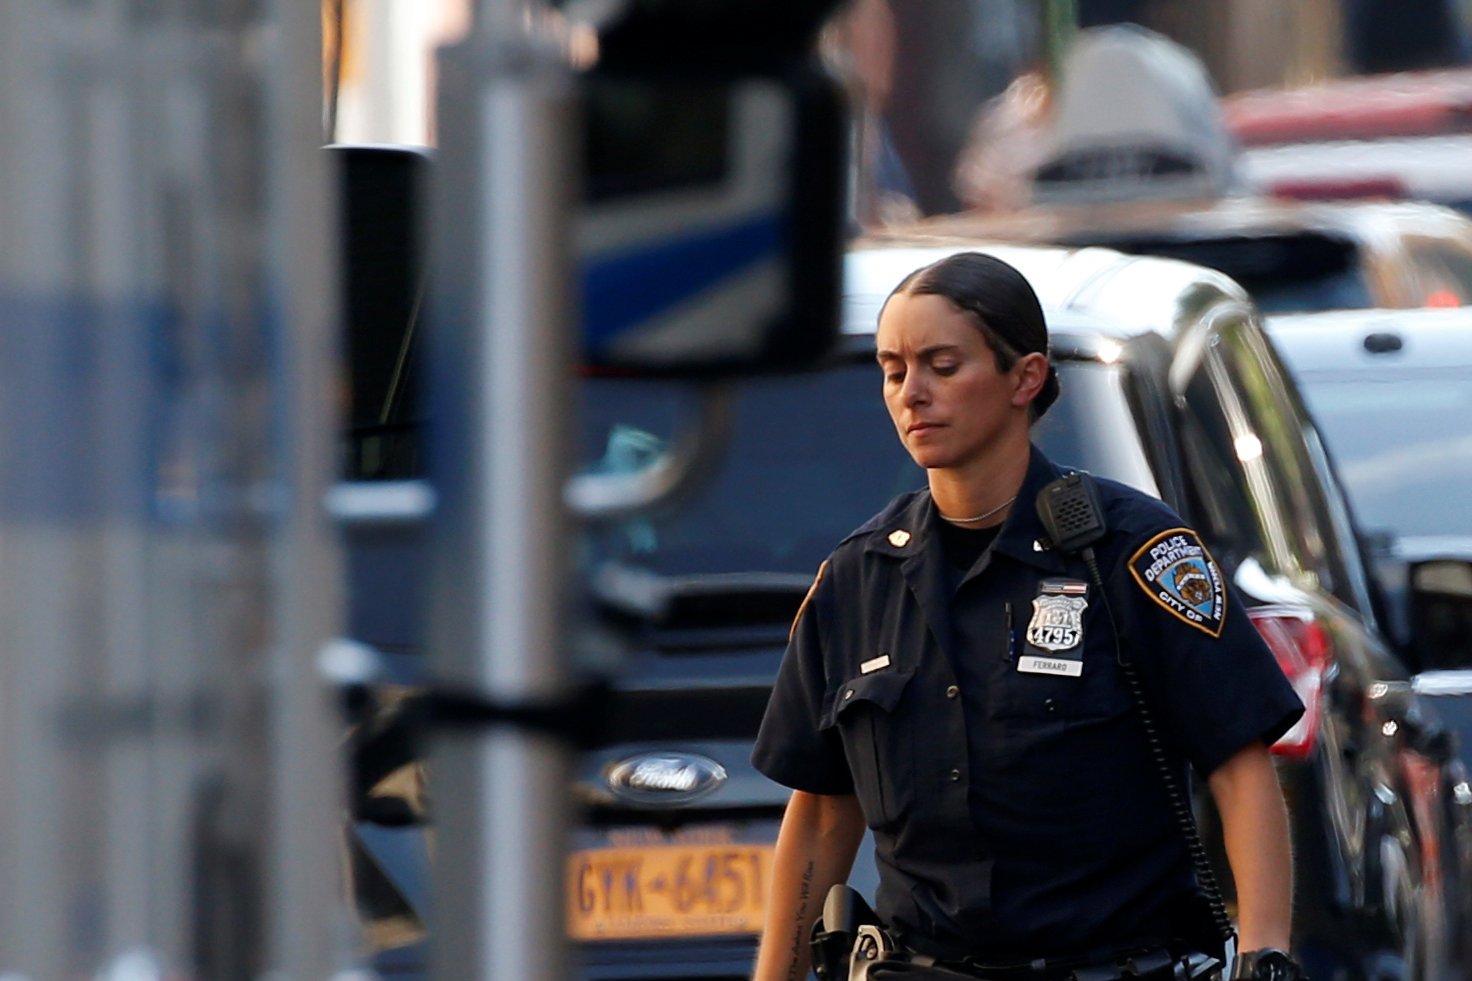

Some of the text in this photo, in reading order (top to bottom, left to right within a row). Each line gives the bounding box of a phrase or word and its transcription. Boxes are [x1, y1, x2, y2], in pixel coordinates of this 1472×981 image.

[1149, 535, 1188, 560] POLICE
[1159, 591, 1203, 622] CITY OF
[1033, 626, 1074, 645] 4795
